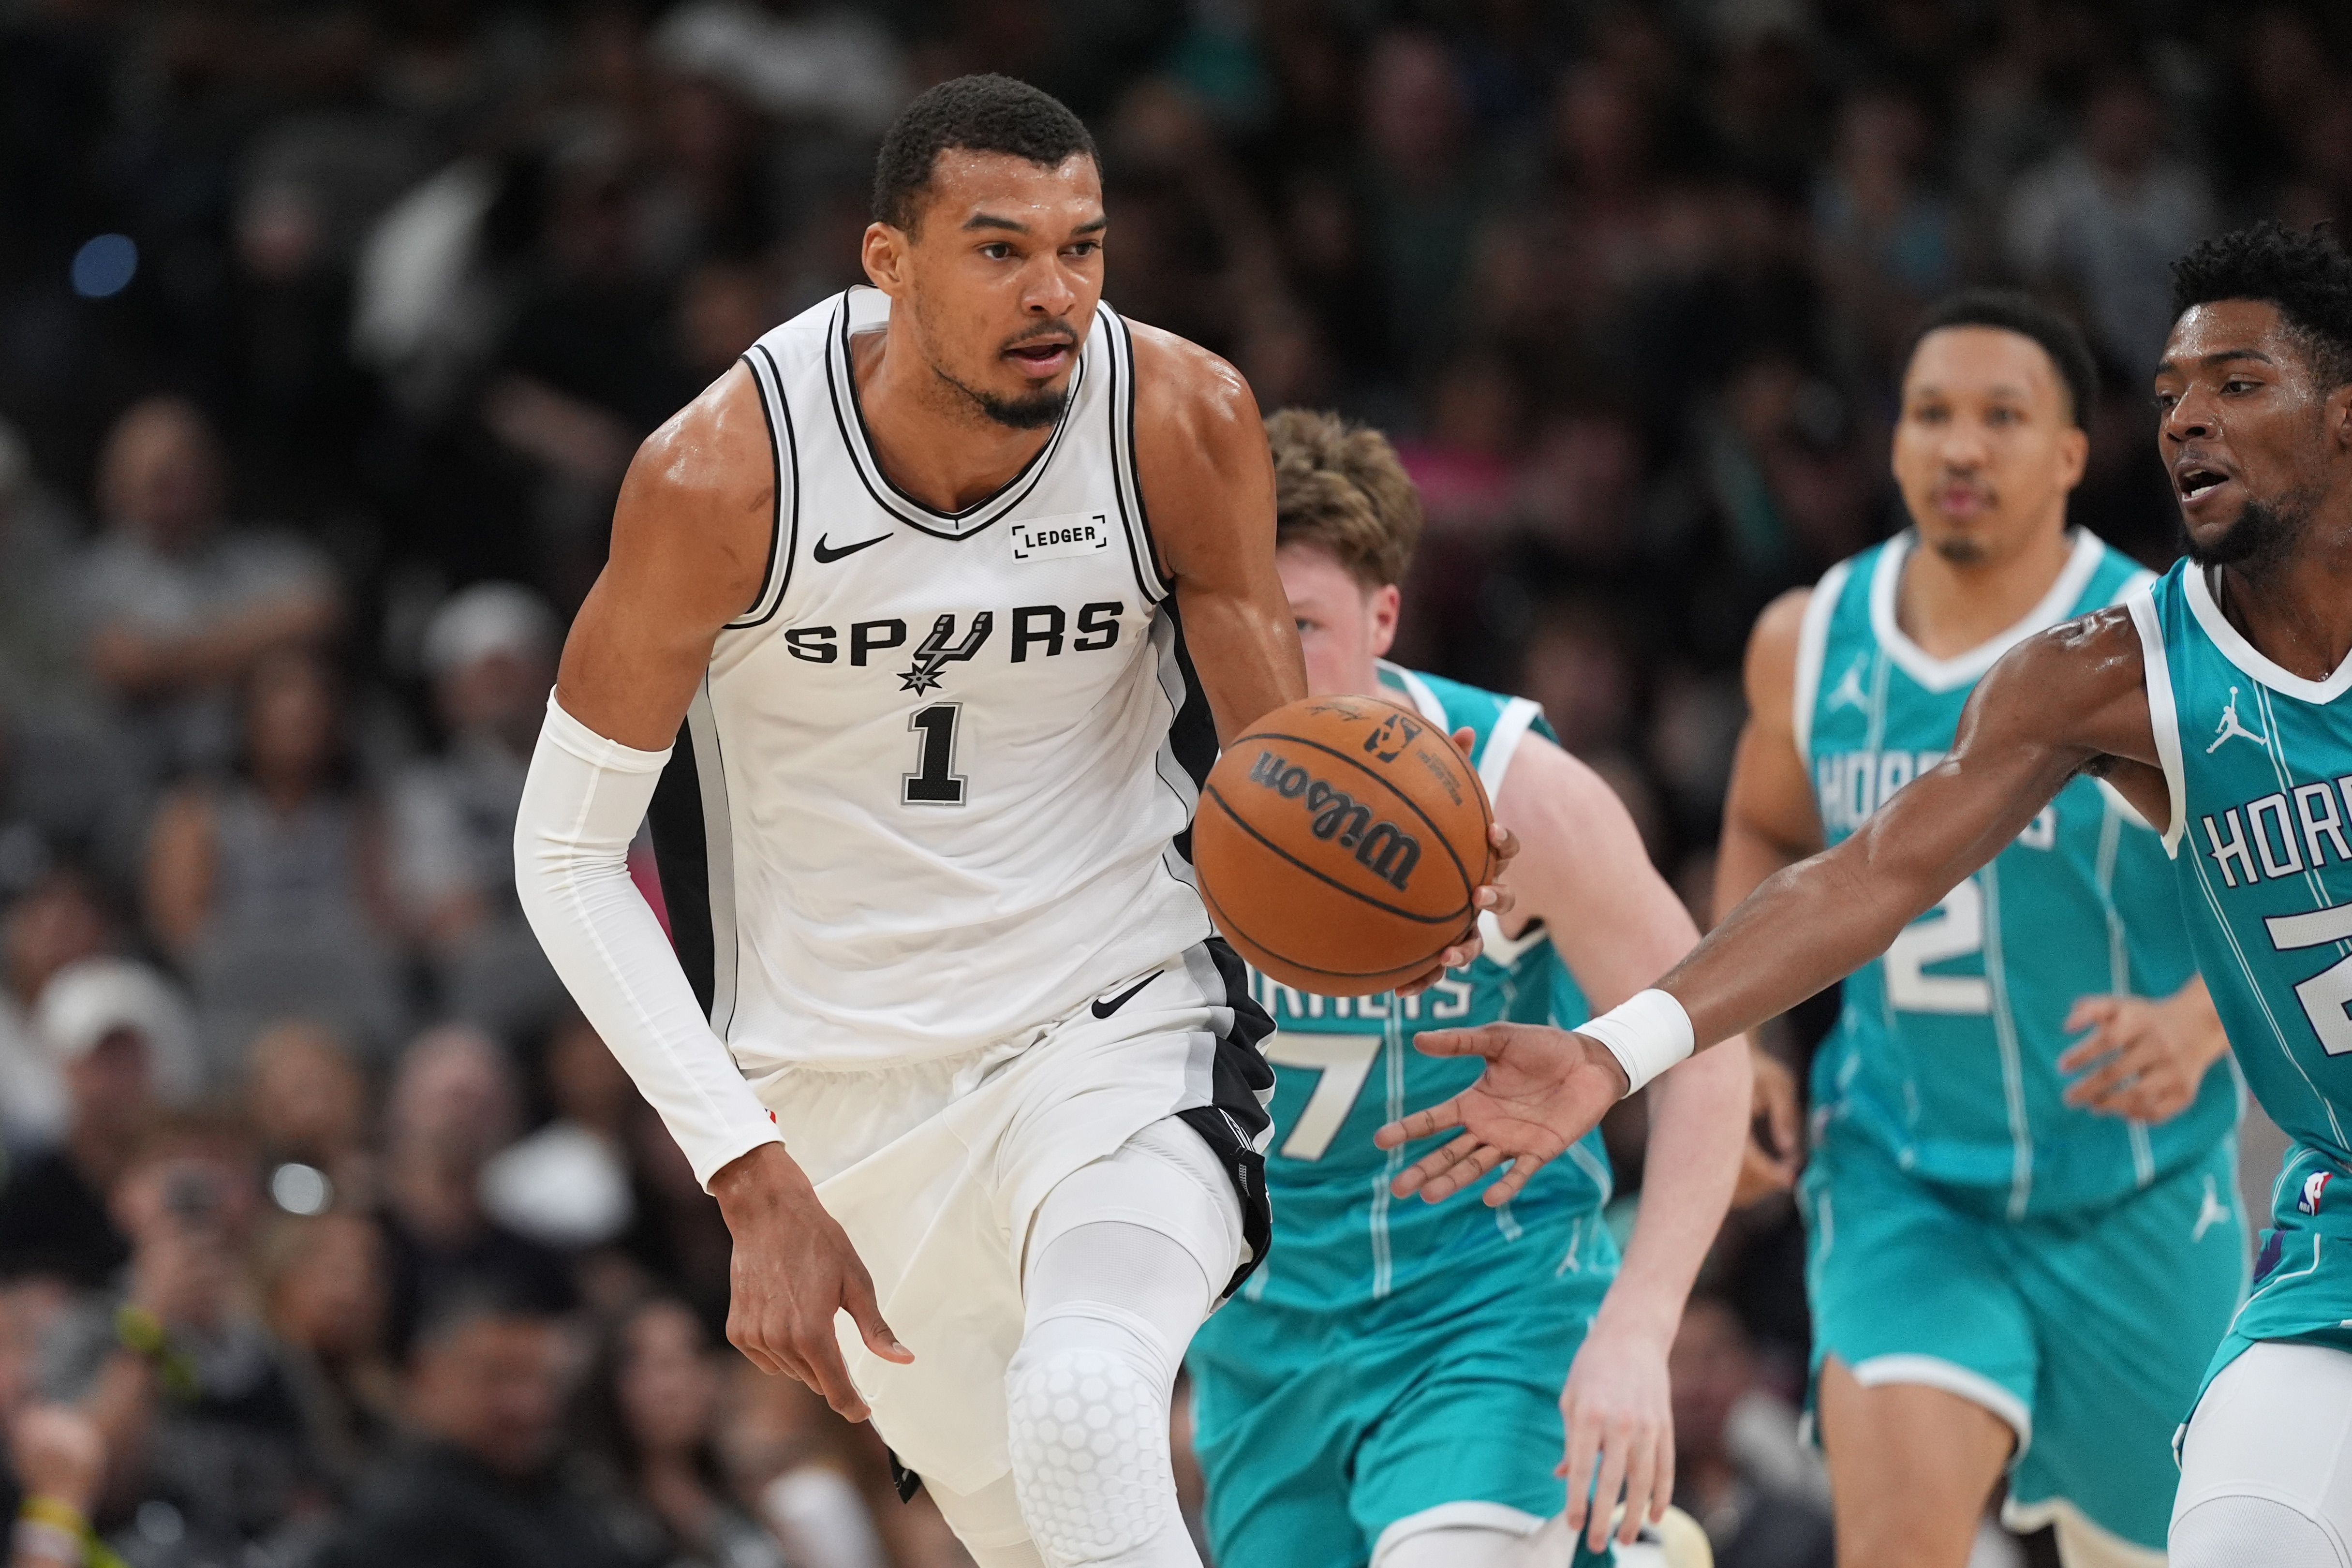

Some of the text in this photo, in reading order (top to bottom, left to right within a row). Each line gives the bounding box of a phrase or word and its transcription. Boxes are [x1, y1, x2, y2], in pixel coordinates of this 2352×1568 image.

[1025, 526, 1095, 548] LEDGER
[784, 601, 1124, 697] SPURS
[900, 702, 967, 807] 1
[1250, 750, 1421, 892] Wilson
[2201, 774, 2352, 889] HOR
[1884, 873, 1995, 1013] 2
[1264, 1029, 1385, 1162] 7
